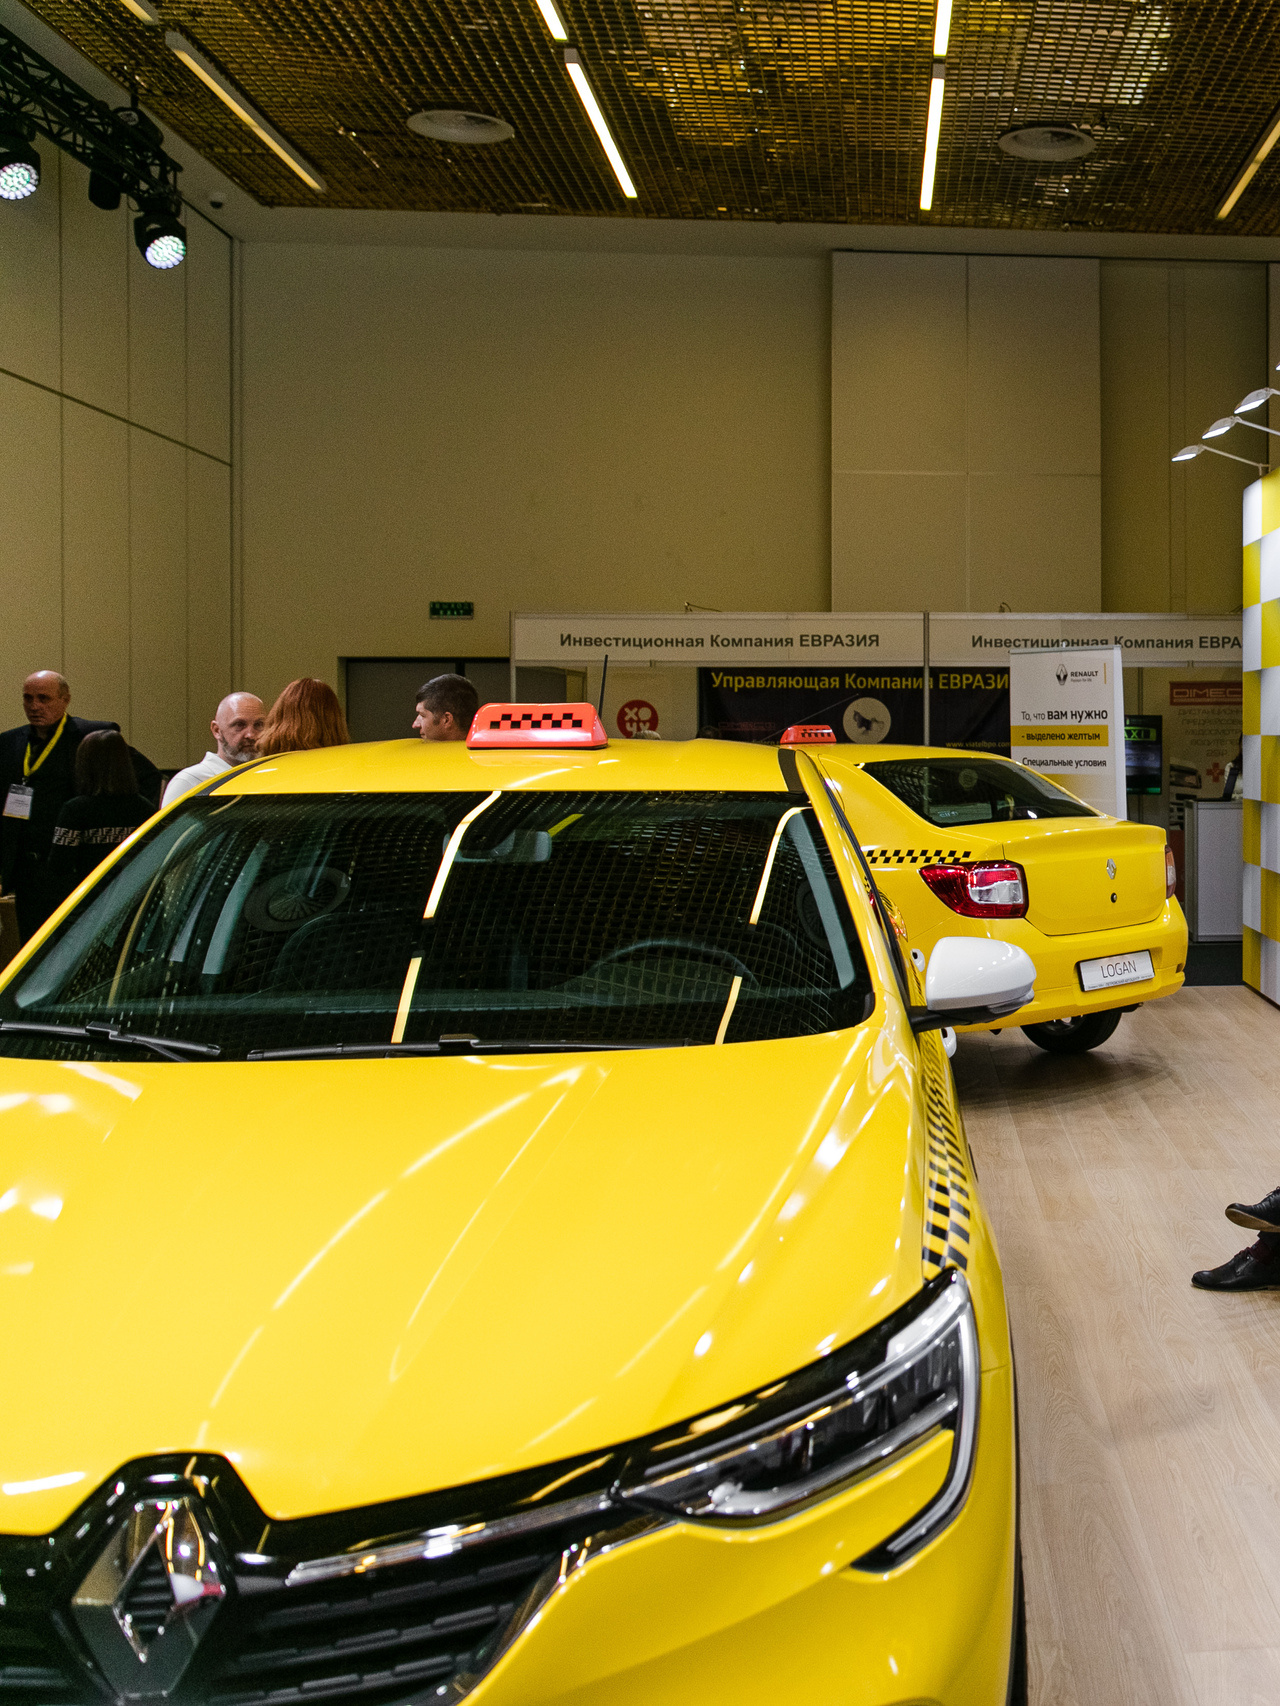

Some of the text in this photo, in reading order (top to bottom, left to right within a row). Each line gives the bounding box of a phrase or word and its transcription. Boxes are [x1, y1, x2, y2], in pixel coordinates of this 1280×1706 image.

[560, 634, 880, 649] Инвестиционная Компания ЕВРАЗИЯ
[1113, 636, 1194, 649] Компания
[1070, 670, 1099, 678] RENAULT
[711, 672, 840, 692] Управляющая
[1021, 709, 1108, 723] То, что вам нужно
[1026, 732, 1066, 741] выделено
[1022, 757, 1107, 769] Специальные условия
[1100, 960, 1137, 978] LOGAN
